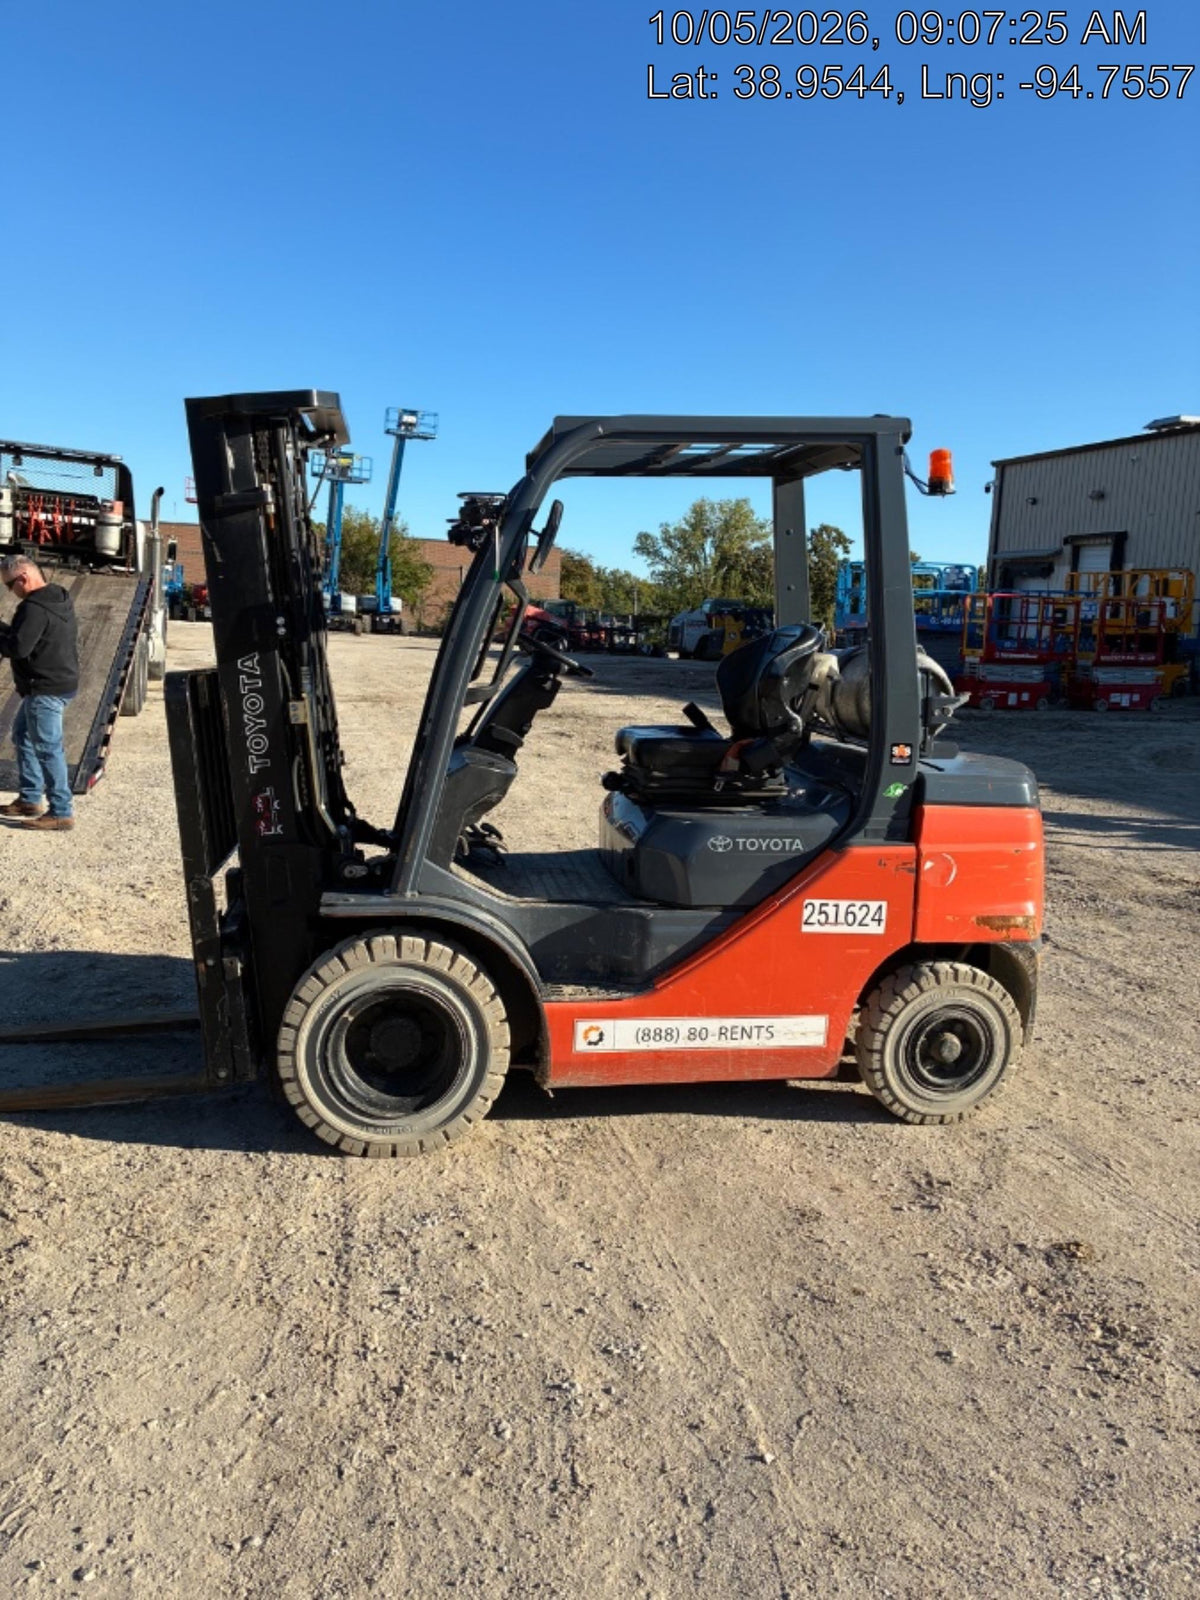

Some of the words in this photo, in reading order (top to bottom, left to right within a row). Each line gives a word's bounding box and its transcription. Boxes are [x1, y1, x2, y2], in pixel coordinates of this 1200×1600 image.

[237, 651, 271, 774] TOYOTA
[736, 838, 804, 851] TOYOTA
[803, 902, 884, 927] 251624
[635, 1026, 681, 1045] (888)
[686, 1025, 775, 1042] 80-RENTS
